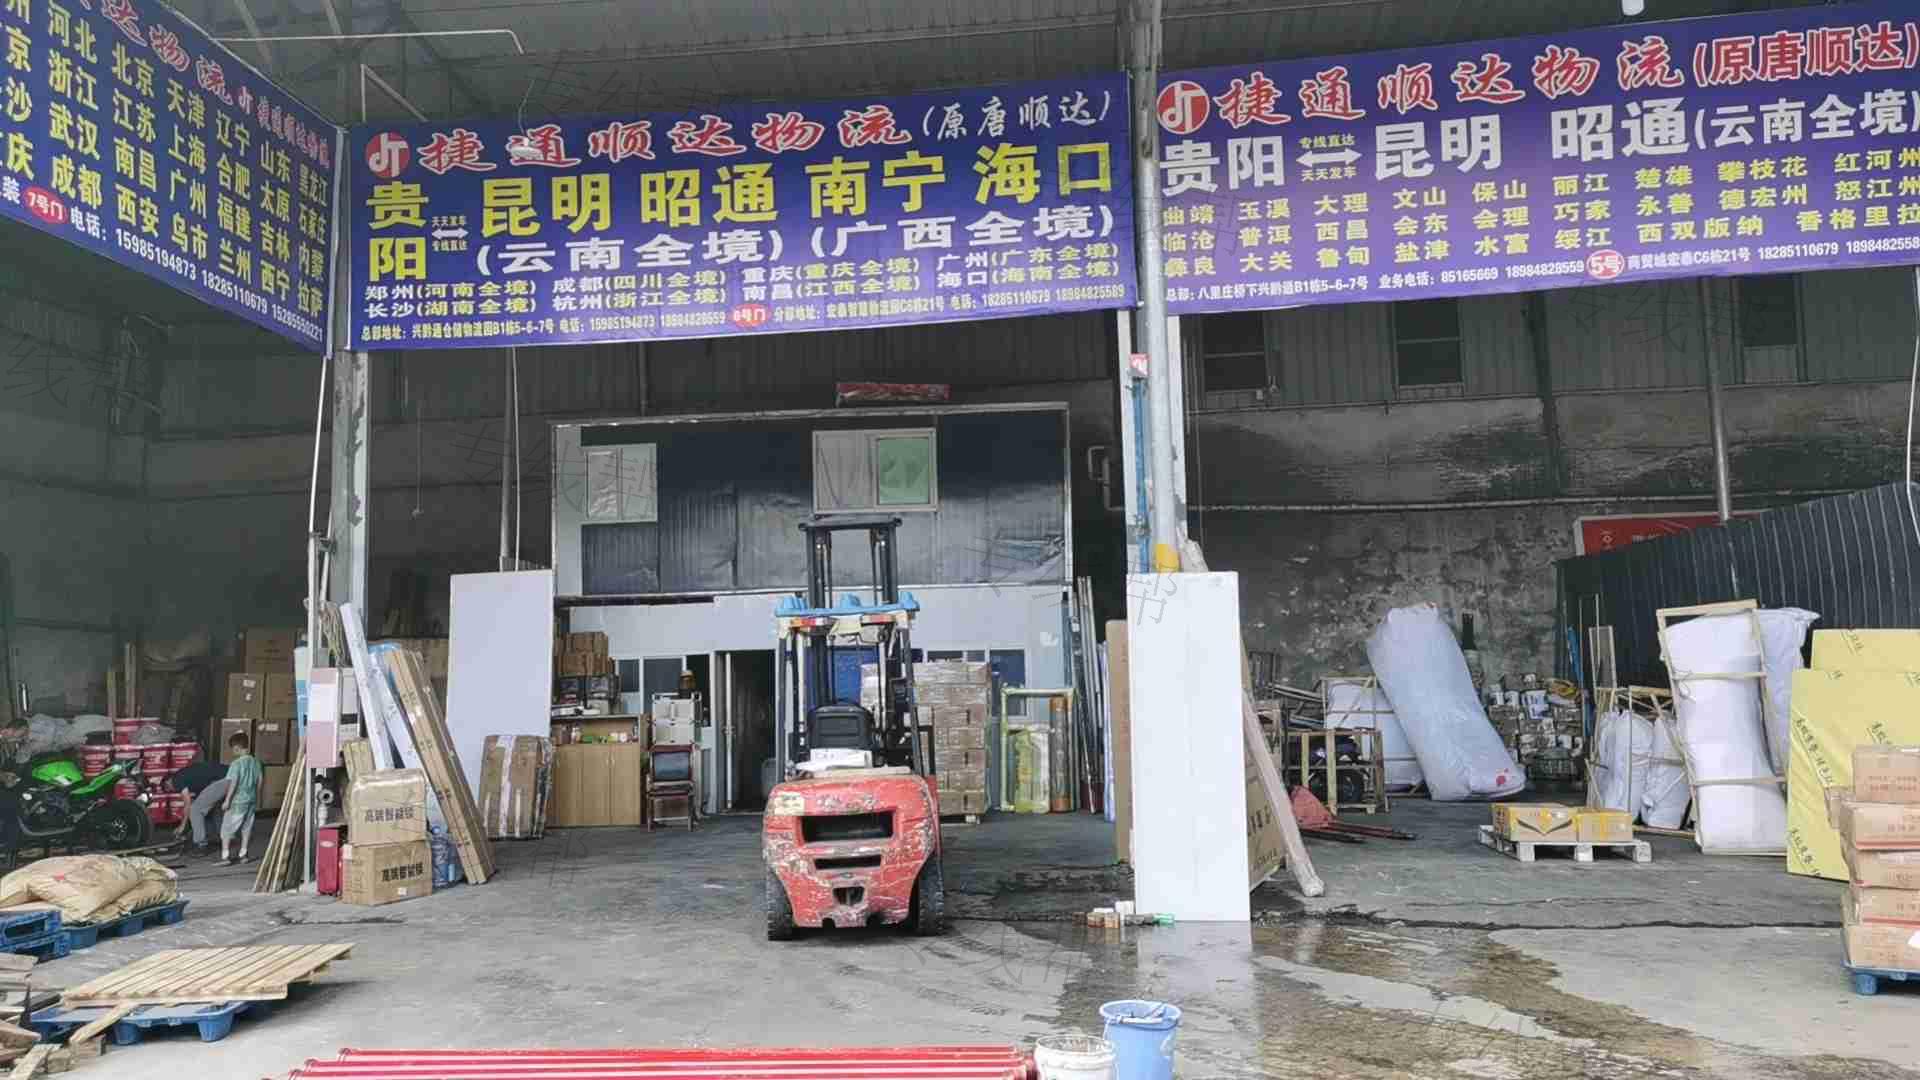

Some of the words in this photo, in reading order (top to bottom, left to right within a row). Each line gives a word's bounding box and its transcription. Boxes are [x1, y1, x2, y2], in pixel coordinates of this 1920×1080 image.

[47, 0, 98, 64] 河北
[112, 43, 154, 98] 北京
[167, 79, 206, 129] 天津
[216, 109, 251, 157] 辽宁
[260, 141, 291, 182] 山东
[48, 48, 99, 111] 浙江
[113, 88, 156, 143] 江苏
[168, 124, 206, 175] 上海
[216, 153, 250, 201] 合肥
[260, 181, 291, 223] 太原
[1159, 136, 1287, 196] 贵阳
[1374, 114, 1503, 181] 昆明
[49, 101, 100, 160] 武汉
[114, 137, 157, 192] 南昌
[170, 170, 207, 219] 广州
[217, 193, 251, 242] 福建
[260, 219, 291, 263] 吉林
[481, 173, 613, 237] 昆明
[640, 162, 778, 228] 昭通
[804, 150, 946, 218] 南宁
[972, 142, 1112, 205] 海口
[1163, 230, 1216, 253] 临沧
[1238, 224, 1292, 248] 普洱
[1314, 219, 1369, 242] 西昌
[1393, 213, 1449, 237] 会东
[1472, 206, 1530, 231] 会理
[1553, 200, 1612, 223] 巧家
[1636, 193, 1694, 217] 永善
[1719, 184, 1808, 210] 德宏州
[1238, 198, 1291, 222] 玉溪
[1313, 192, 1369, 216] 大理
[1393, 187, 1447, 210] 文山
[1472, 180, 1528, 204] 保山
[1552, 173, 1609, 197] 丽江
[1635, 165, 1693, 190] 楚雄
[1717, 156, 1808, 183] 攀枝花
[52, 154, 103, 210] 成都
[115, 184, 159, 238] 西安
[171, 212, 208, 261] 乌市
[219, 238, 251, 286] 兰州
[260, 260, 291, 302] 西宁
[477, 229, 782, 276] (云南全境)
[811, 204, 1114, 258] (广西全境)
[1239, 251, 1293, 273] 大关
[1316, 246, 1370, 268] 鲁甸
[1394, 239, 1450, 264] 盐津
[1474, 234, 1530, 256] 水富
[1554, 226, 1613, 251] 绥江
[1637, 215, 1765, 244] 西双版纳
[1796, 203, 1920, 233] 香格里拉
[1590, 254, 1622, 274] 5号
[1758, 242, 1839, 260] 18285110679
